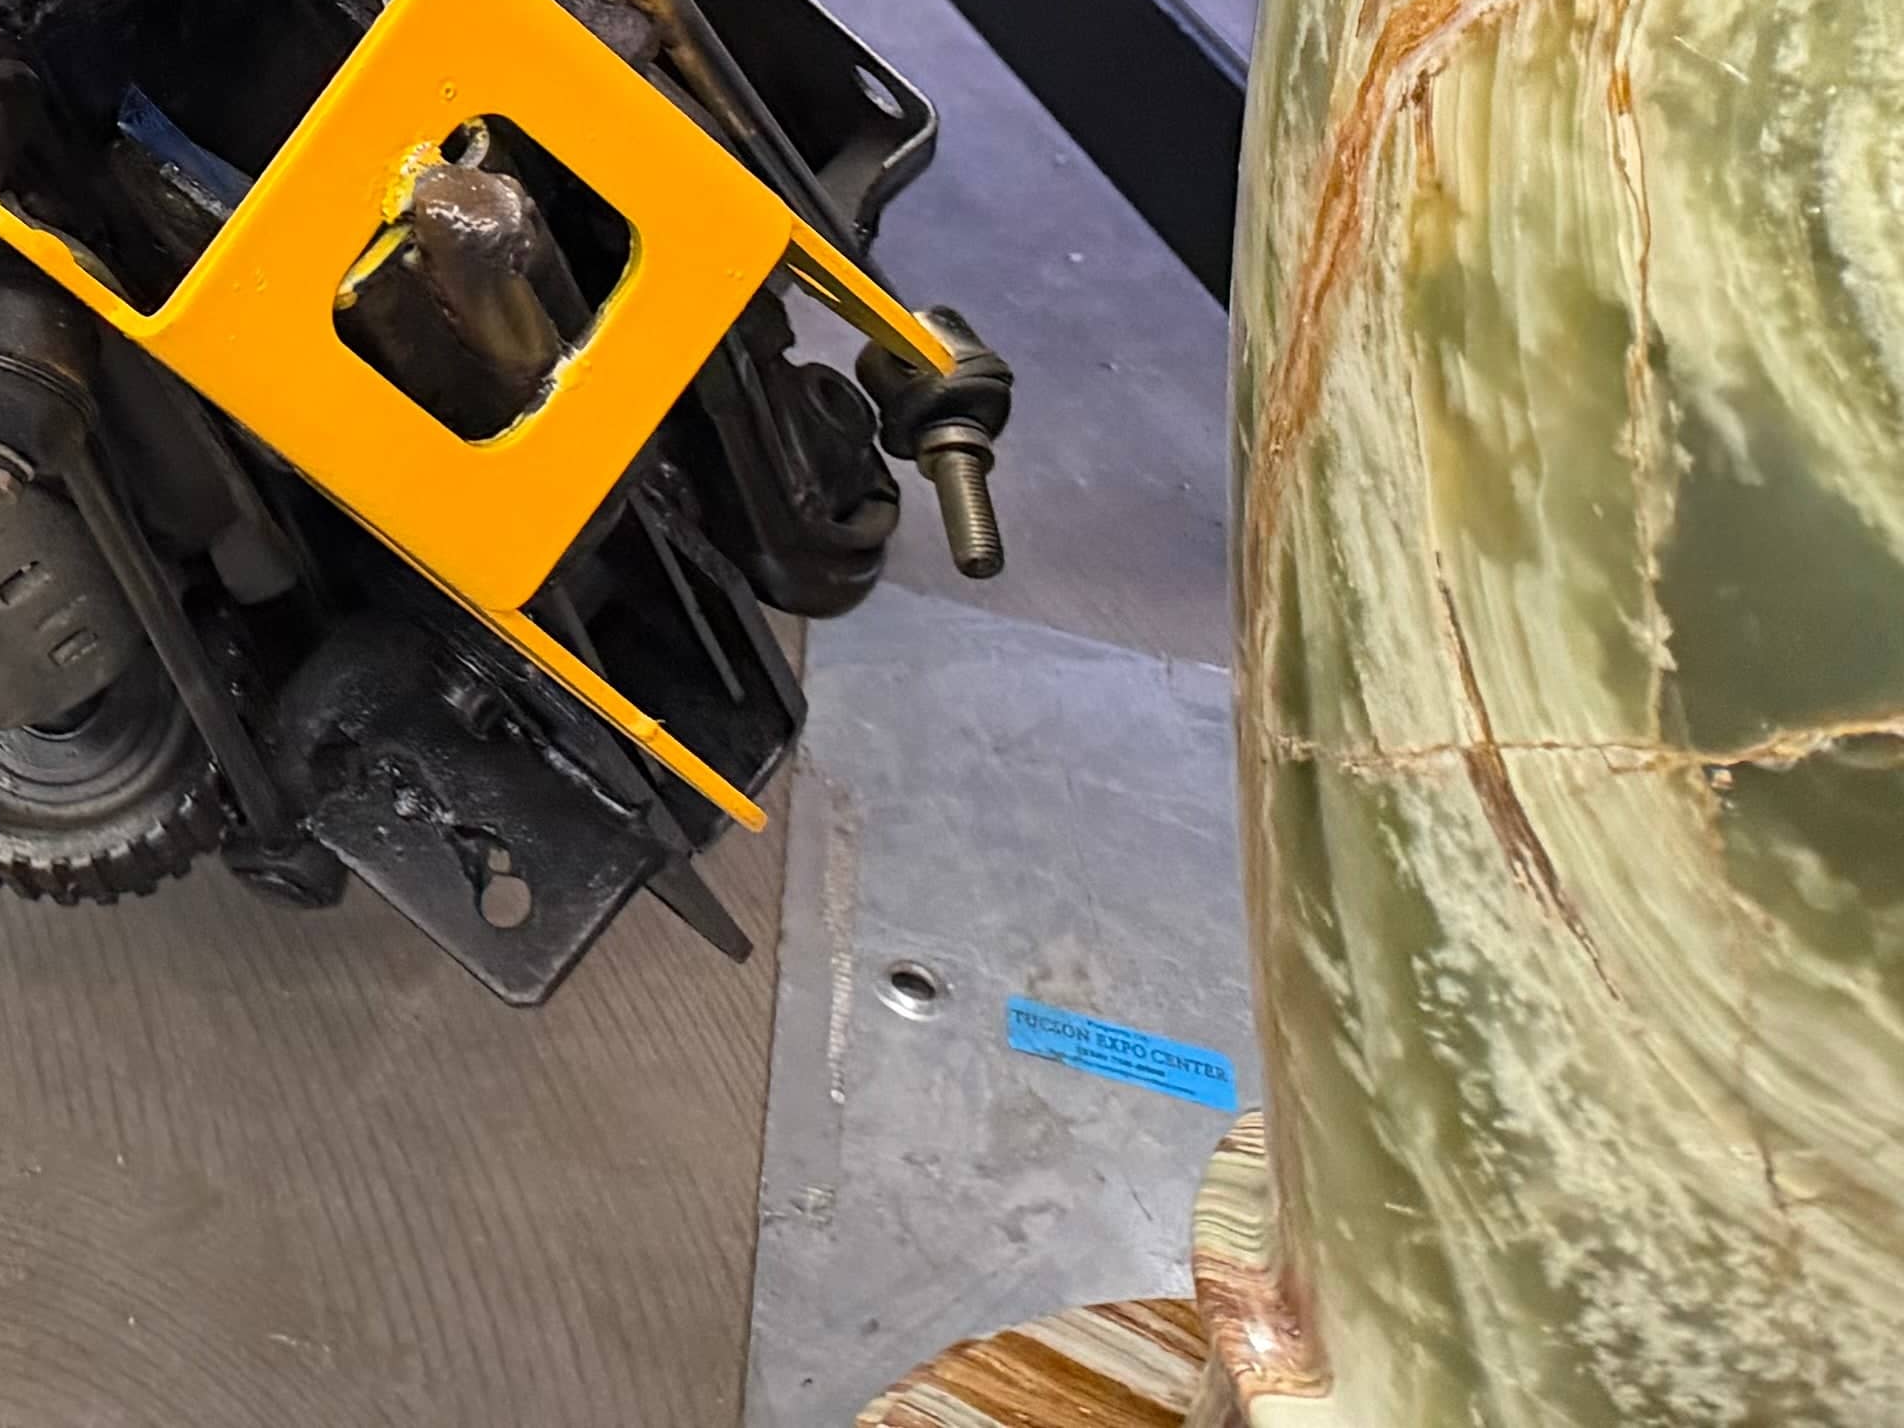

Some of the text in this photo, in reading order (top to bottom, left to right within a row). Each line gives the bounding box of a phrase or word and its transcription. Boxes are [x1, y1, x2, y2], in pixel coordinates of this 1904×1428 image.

[1011, 1009, 1090, 1041] TUCSON
[1095, 1032, 1147, 1058] EXPO
[1151, 1049, 1229, 1082] CENTER
